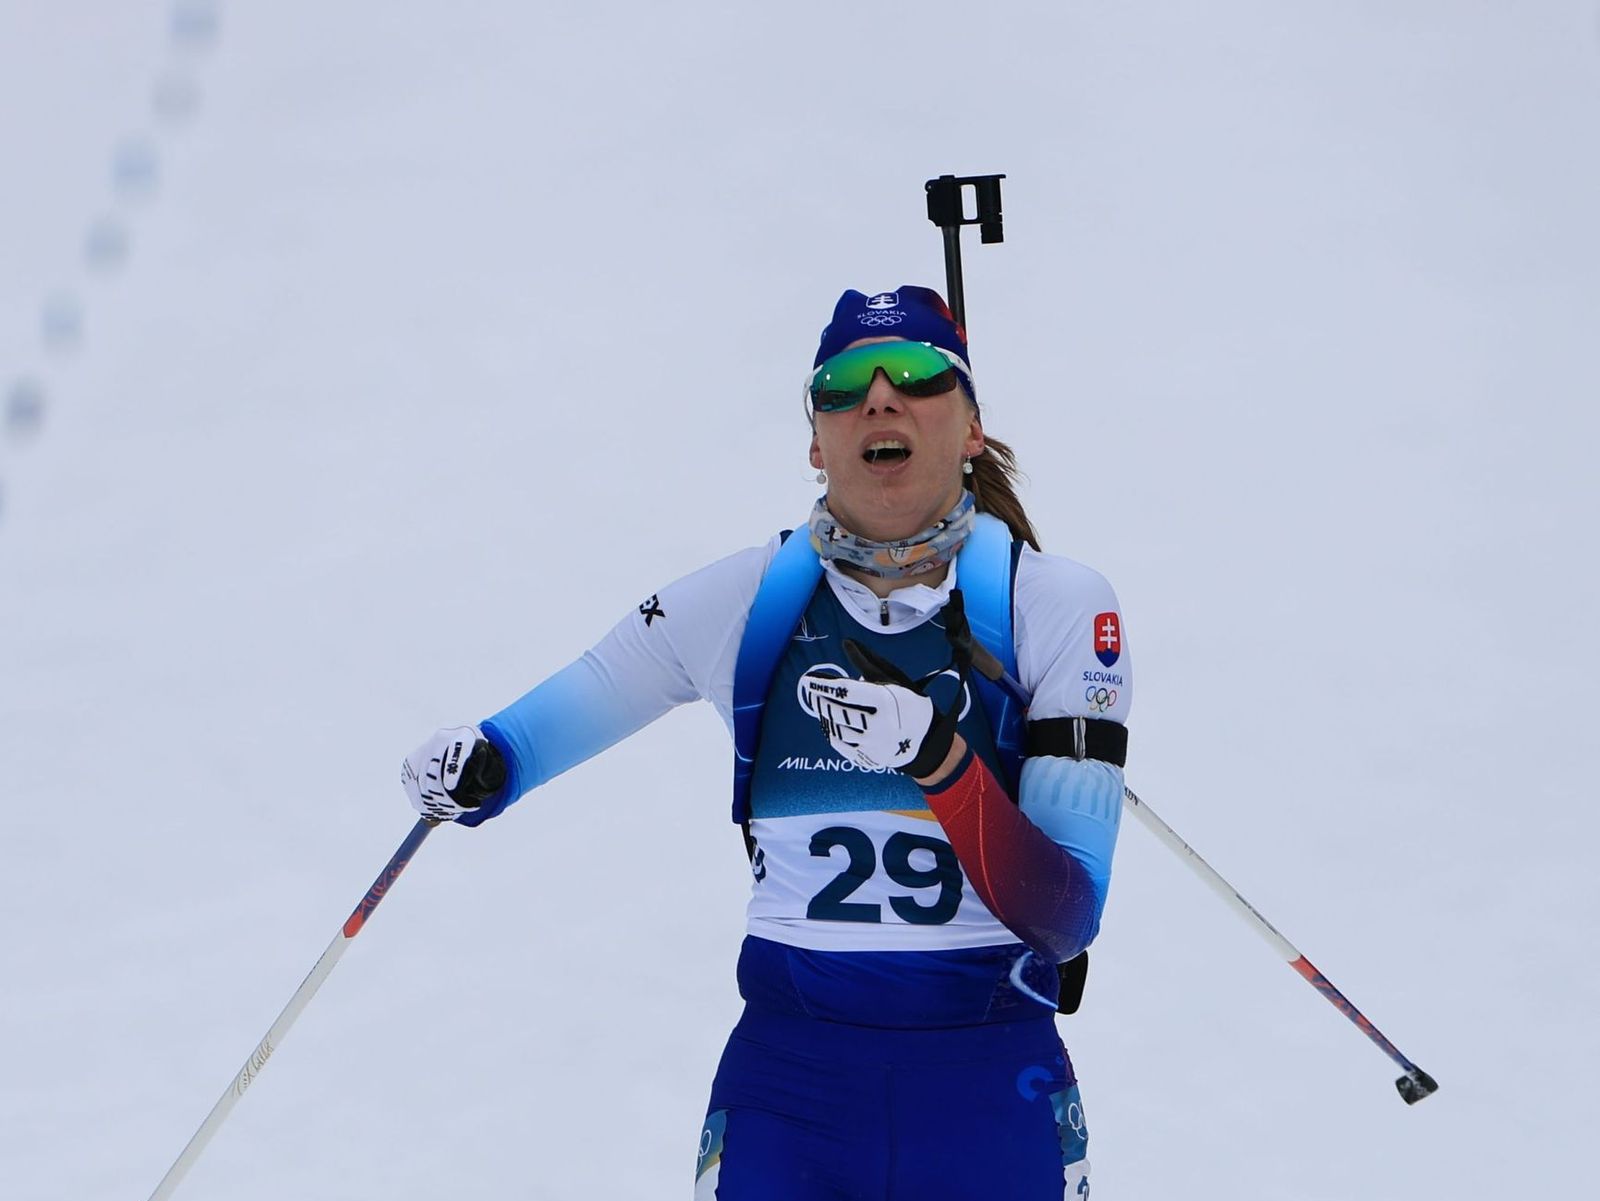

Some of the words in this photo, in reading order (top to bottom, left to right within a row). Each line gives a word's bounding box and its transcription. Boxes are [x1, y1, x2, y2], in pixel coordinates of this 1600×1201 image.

[857, 310, 907, 319] SLOVAKIA
[1082, 671, 1123, 687] SLOVAKIA
[777, 756, 855, 773] MILANO
[806, 826, 964, 925] 29
